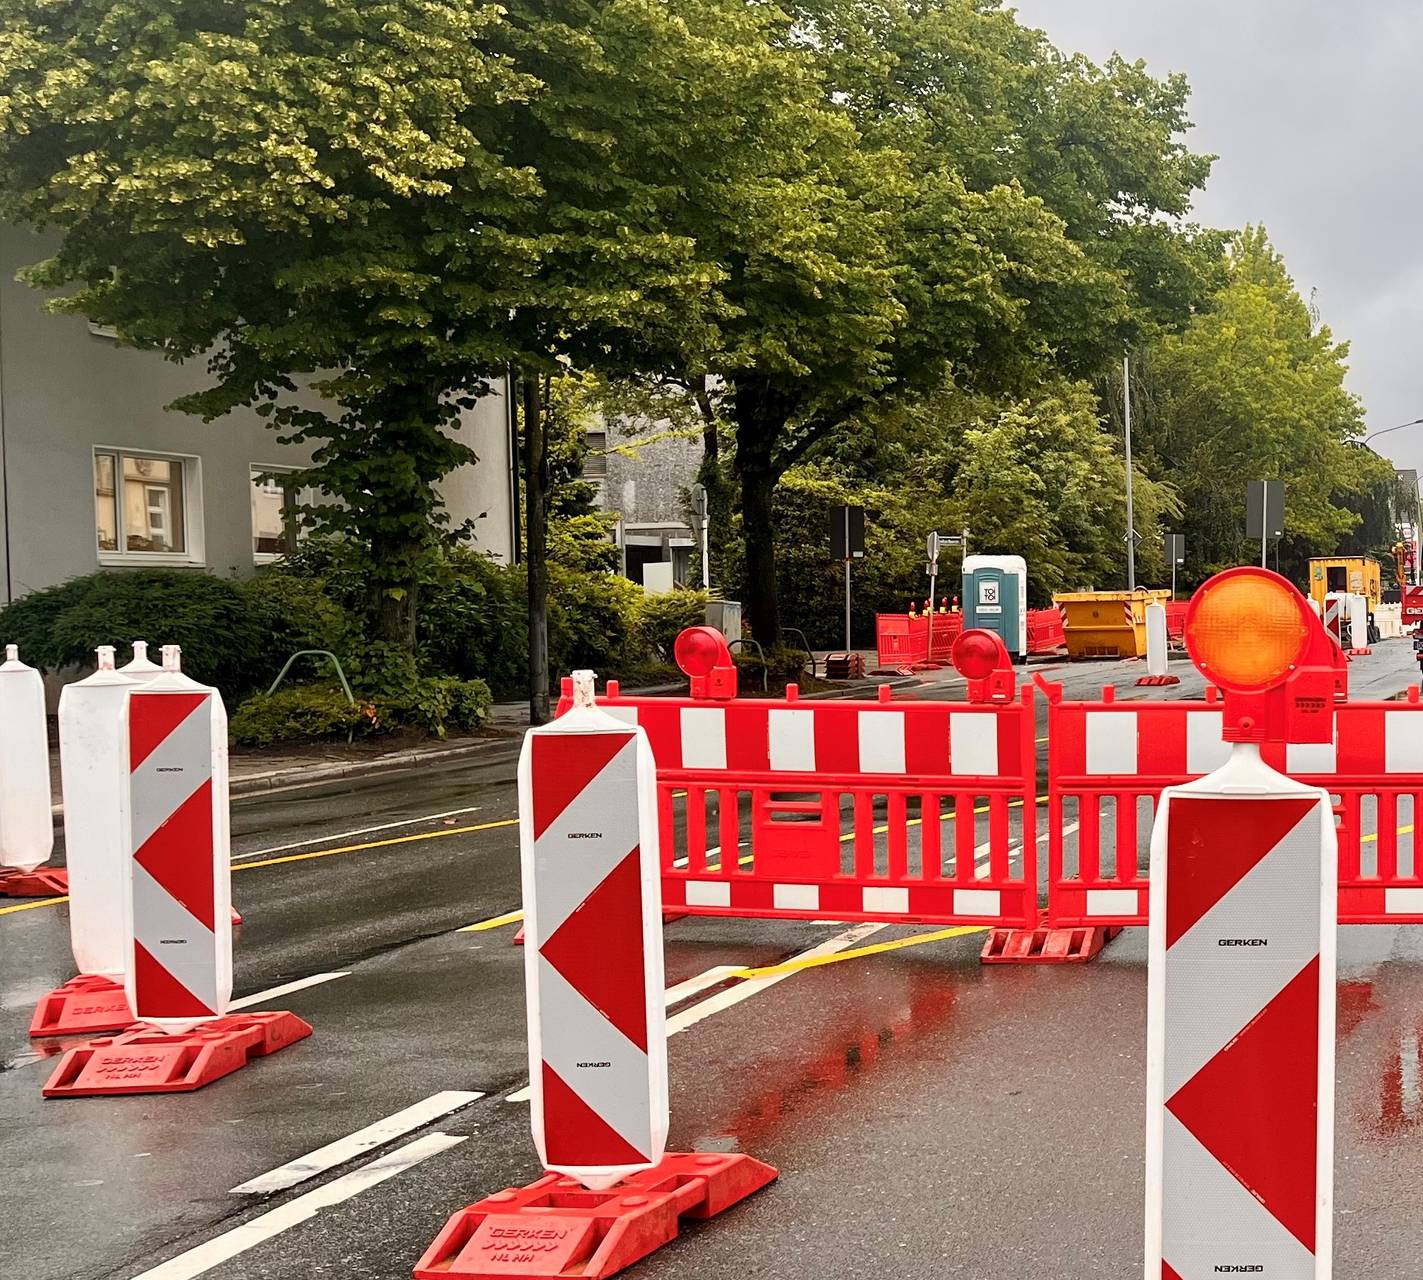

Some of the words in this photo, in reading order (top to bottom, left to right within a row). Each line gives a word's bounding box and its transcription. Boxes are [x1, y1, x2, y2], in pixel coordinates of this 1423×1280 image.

[72, 1004, 129, 1015] GERKE
[101, 1055, 166, 1065] GERKEN
[489, 1228, 568, 1240] GERKEN
